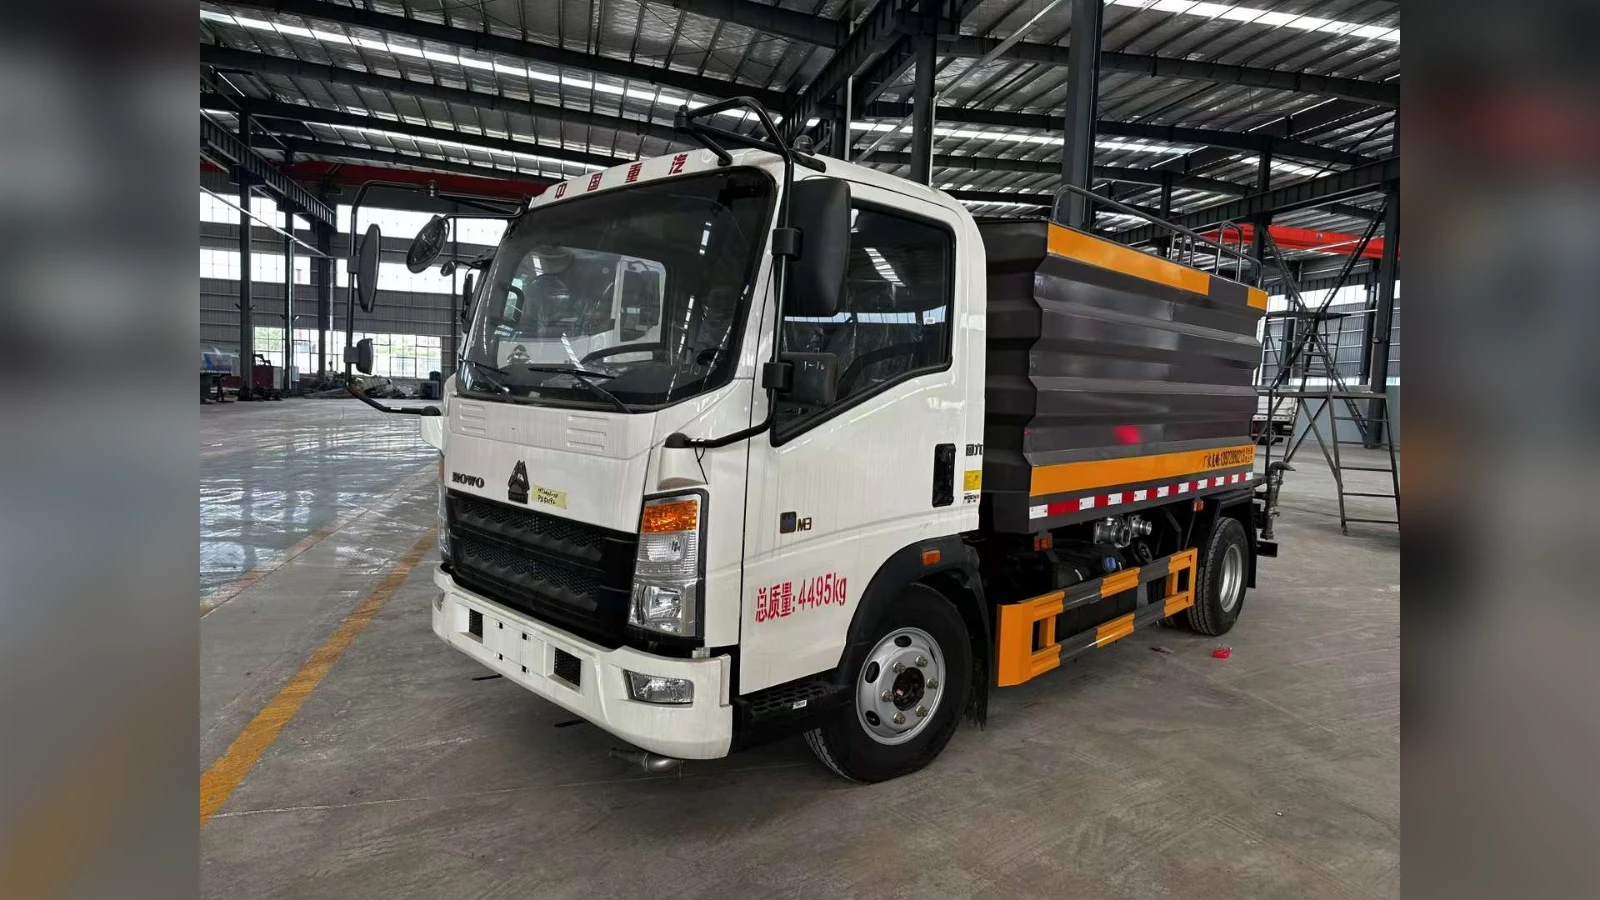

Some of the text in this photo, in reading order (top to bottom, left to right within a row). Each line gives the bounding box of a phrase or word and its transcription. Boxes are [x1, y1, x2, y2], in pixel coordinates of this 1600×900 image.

[555, 154, 688, 199] 中国重汽
[452, 472, 485, 488] HOWO
